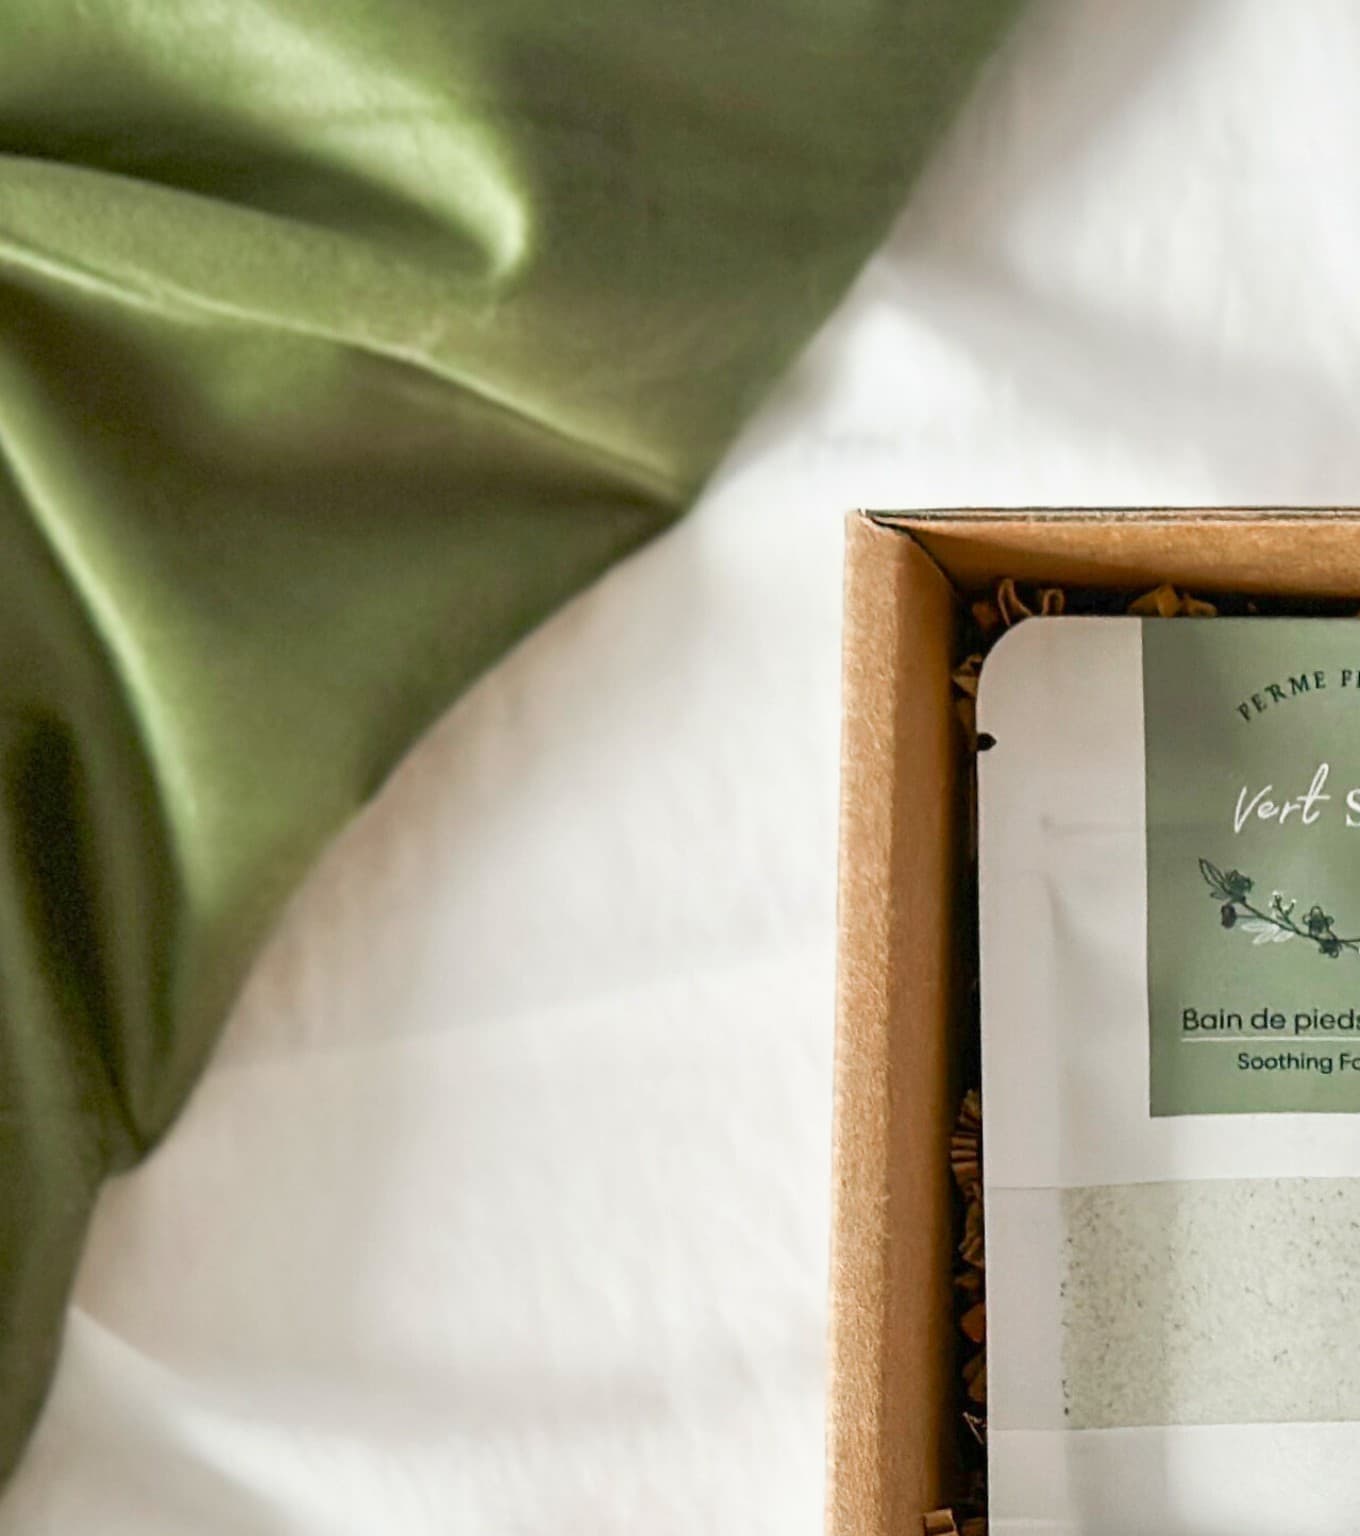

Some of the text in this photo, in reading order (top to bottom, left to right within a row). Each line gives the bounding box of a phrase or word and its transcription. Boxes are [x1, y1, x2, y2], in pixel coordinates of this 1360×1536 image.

[1236, 671, 1326, 722] FERME
[1233, 763, 1330, 833] Vert
[1182, 1008, 1242, 1031] Bain
[1250, 1008, 1285, 1030] de
[1237, 1052, 1333, 1074] Soothing
